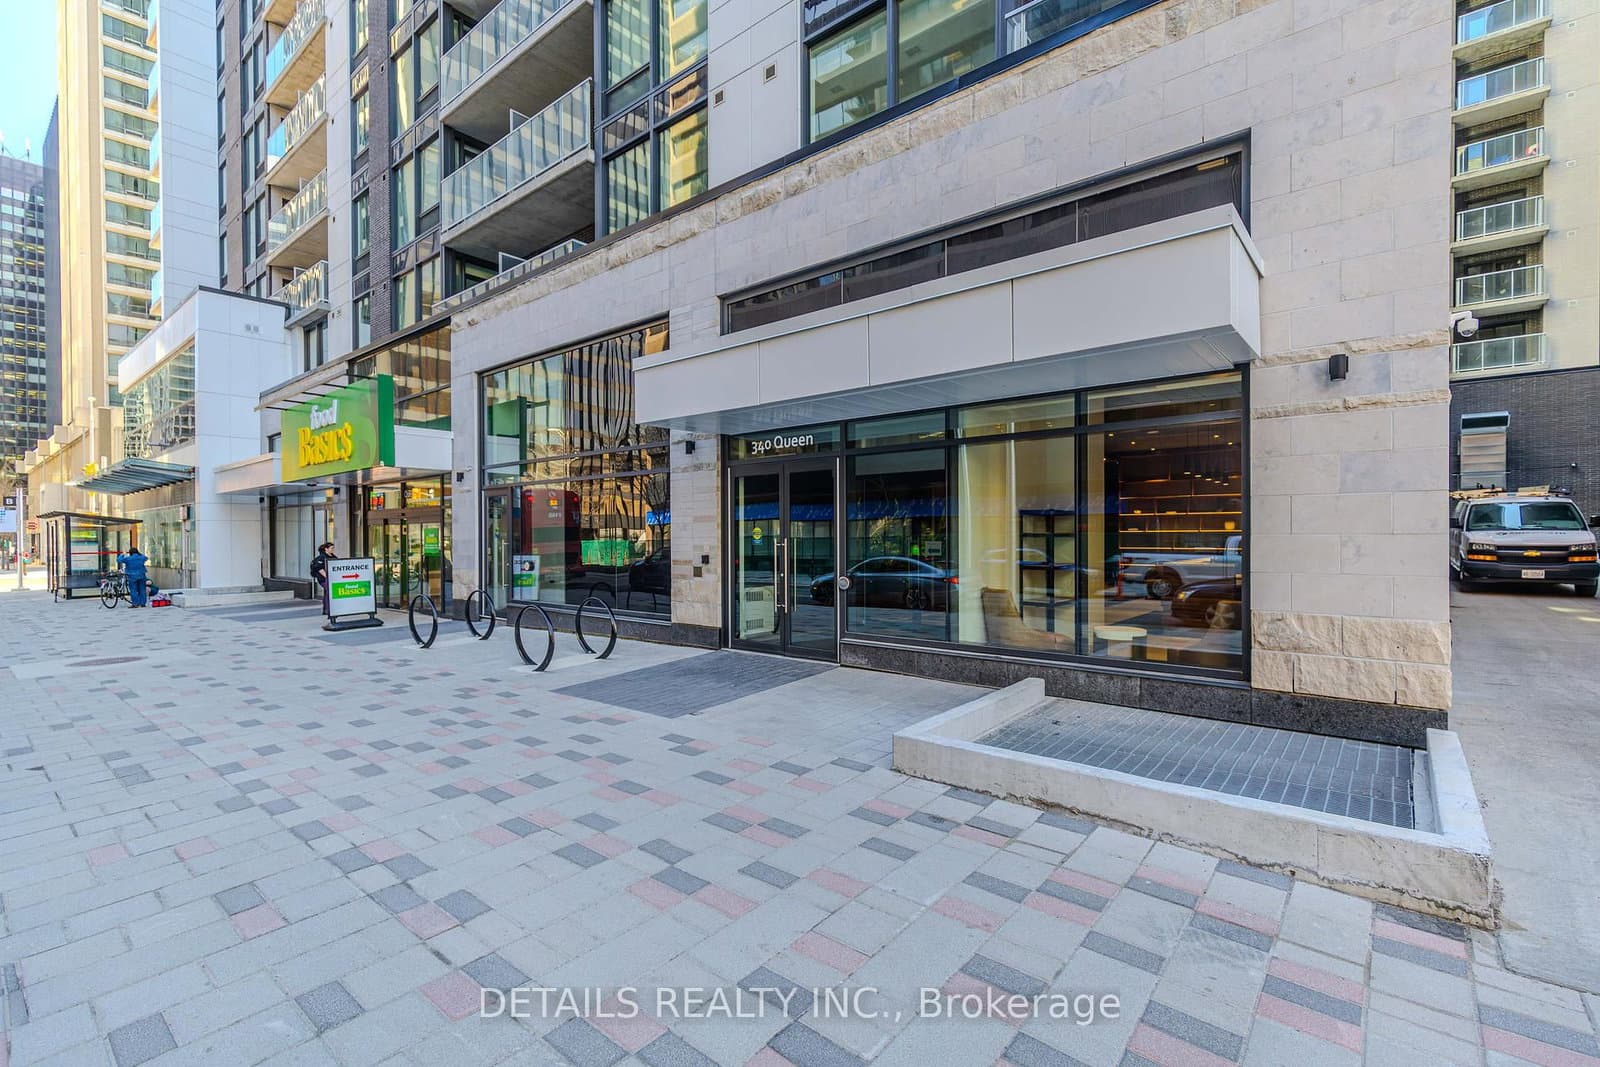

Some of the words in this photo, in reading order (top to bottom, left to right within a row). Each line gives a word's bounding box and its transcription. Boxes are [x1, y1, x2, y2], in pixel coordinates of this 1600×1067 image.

[310, 400, 338, 430] food
[751, 440, 771, 455] 340
[774, 434, 813, 449] Queen
[332, 564, 369, 572] ENTRANCE
